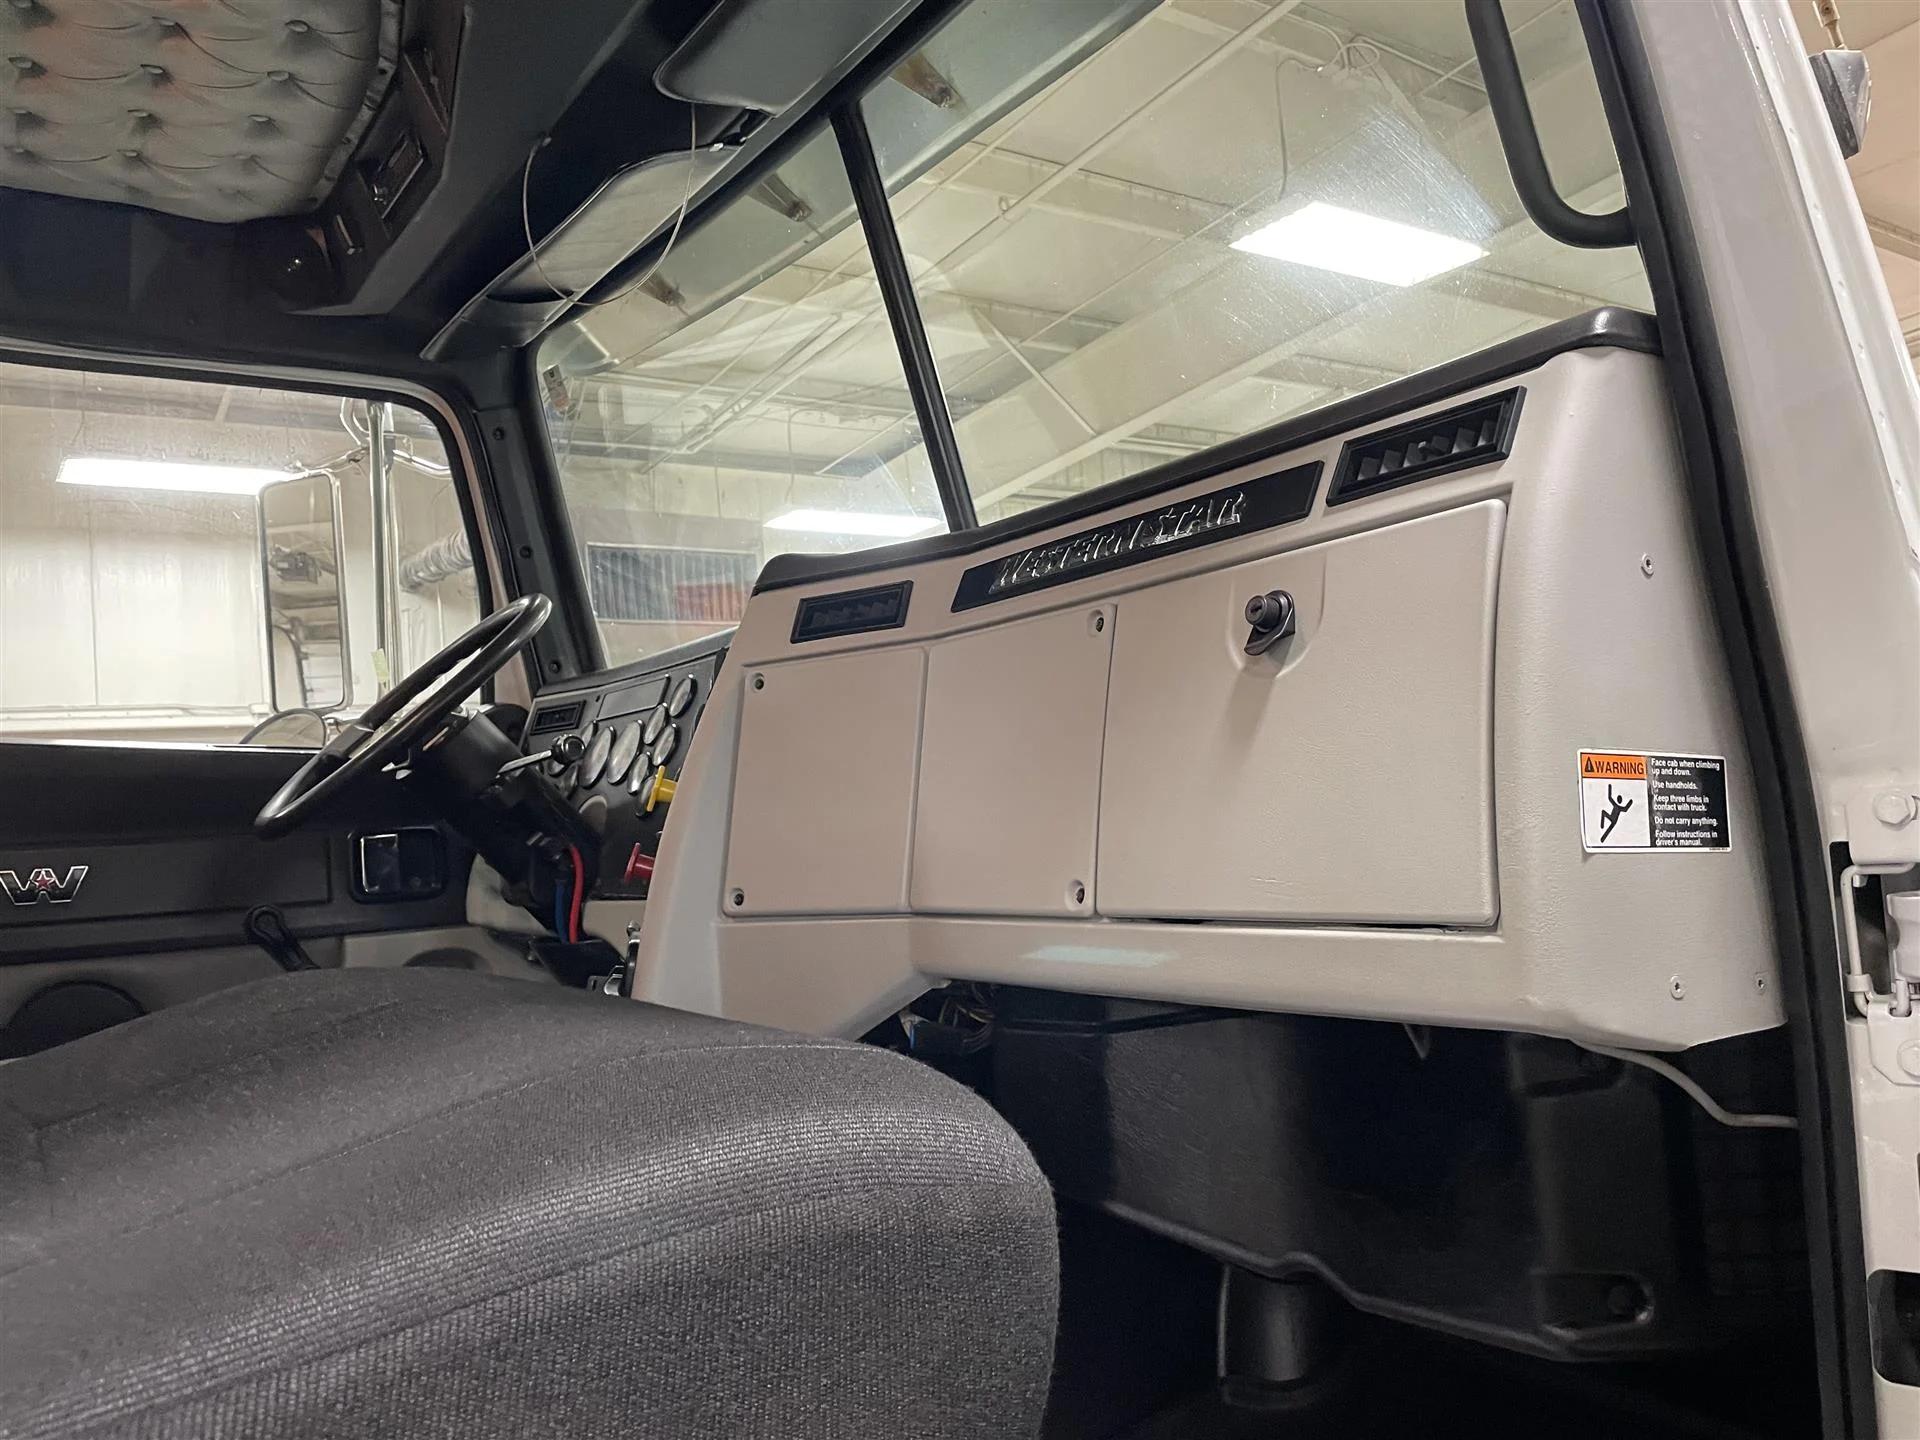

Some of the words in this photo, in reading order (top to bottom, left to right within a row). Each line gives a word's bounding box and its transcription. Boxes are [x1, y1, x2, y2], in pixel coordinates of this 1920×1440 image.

[996, 519, 1146, 589] WESTERN
[1154, 490, 1245, 545] STAR
[1595, 761, 1644, 775] WARNING
[1651, 758, 1666, 766] Face
[1696, 762, 1720, 770] climbing
[1654, 795, 1669, 803] Keep
[1686, 795, 1702, 803] limbs
[1692, 818, 1718, 827] anything.
